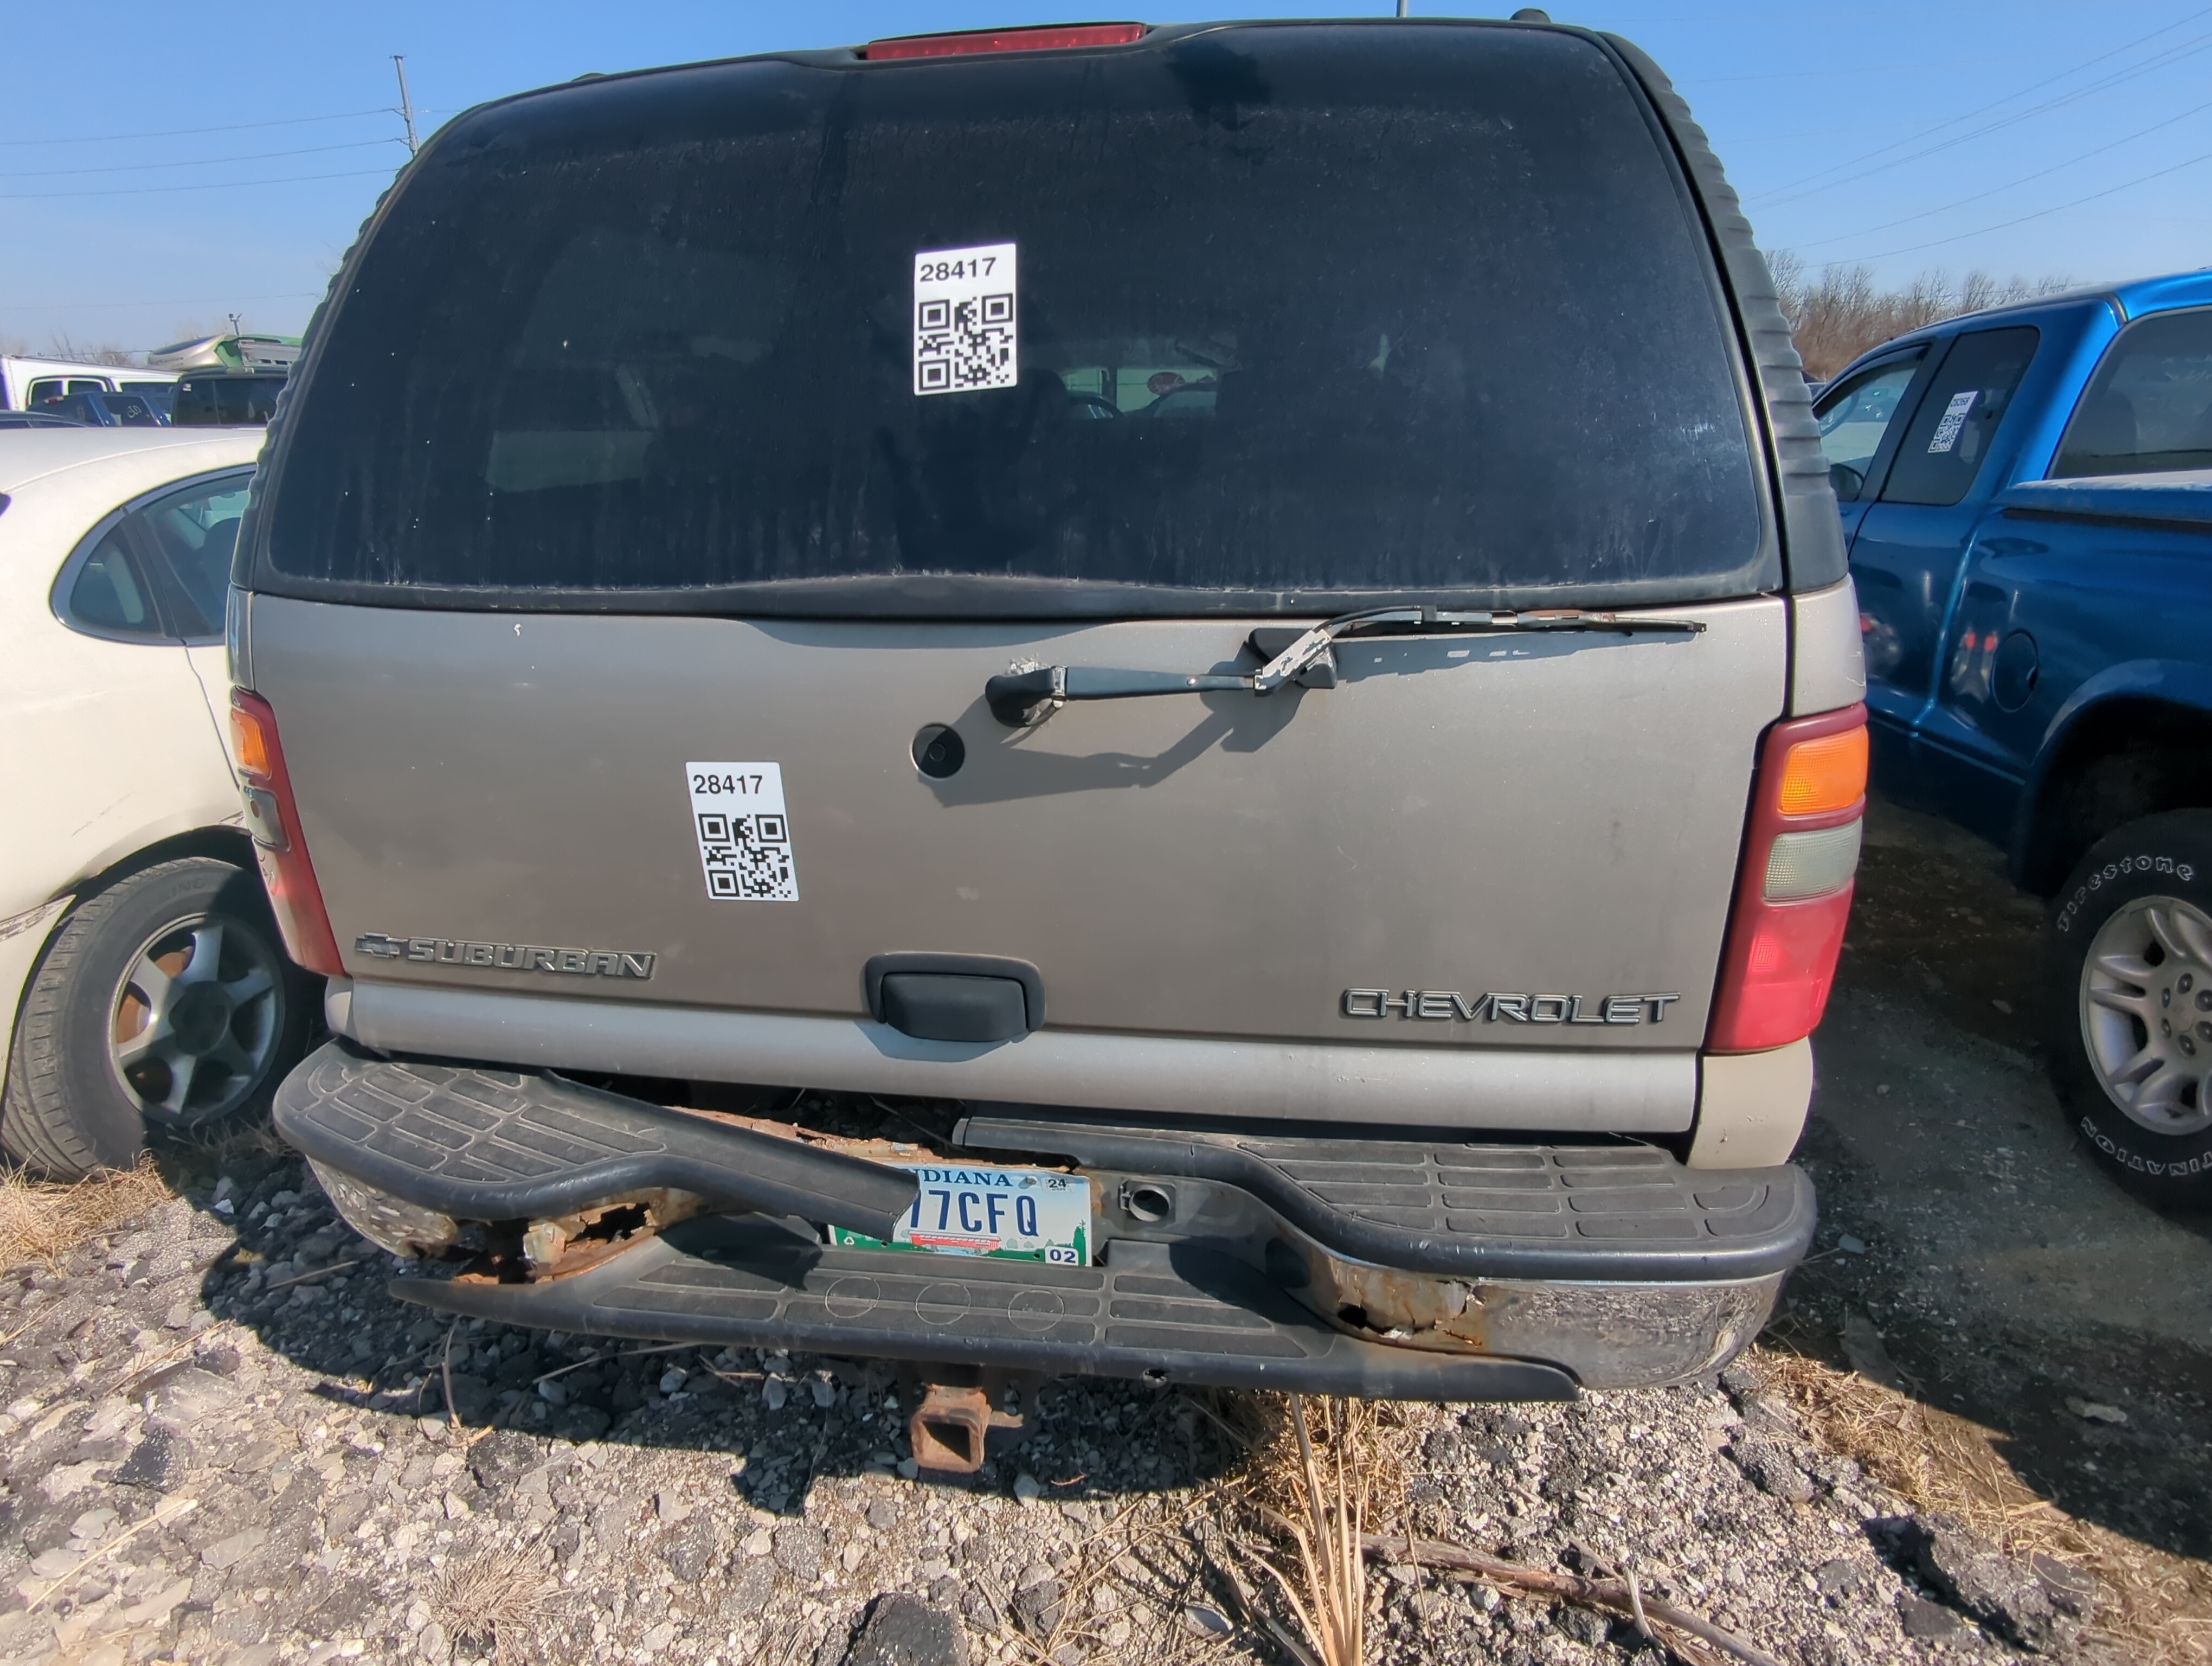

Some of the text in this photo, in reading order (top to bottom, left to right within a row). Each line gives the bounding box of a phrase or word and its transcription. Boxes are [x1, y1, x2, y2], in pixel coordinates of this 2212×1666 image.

[919, 257, 996, 282] 28417
[693, 774, 763, 794] 28417
[408, 937, 656, 979] SUBURBAN
[1345, 988, 1681, 1023] CHEVROLET
[1048, 1178, 1066, 1188] 24
[1050, 1249, 1076, 1264] 02
